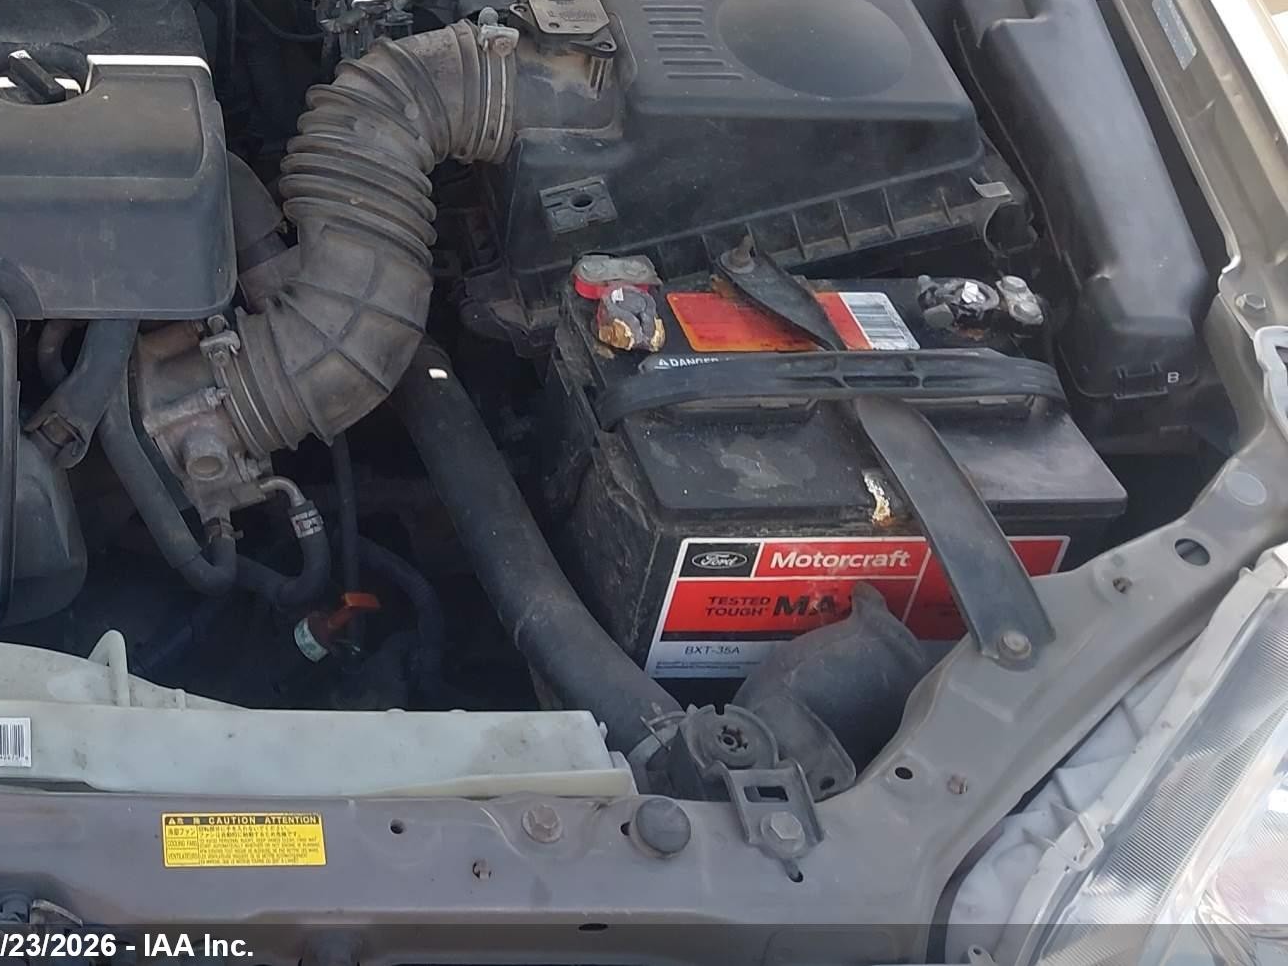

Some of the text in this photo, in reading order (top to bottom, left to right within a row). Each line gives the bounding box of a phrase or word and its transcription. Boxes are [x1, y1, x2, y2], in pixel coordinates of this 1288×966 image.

[1167, 371, 1180, 383] B
[701, 550, 911, 569] Ford Motorcraft
[708, 596, 771, 605] TESTED
[684, 646, 740, 655] BXT-35A
[208, 816, 256, 825] CAUTION
[264, 816, 317, 824] ATTENTION
